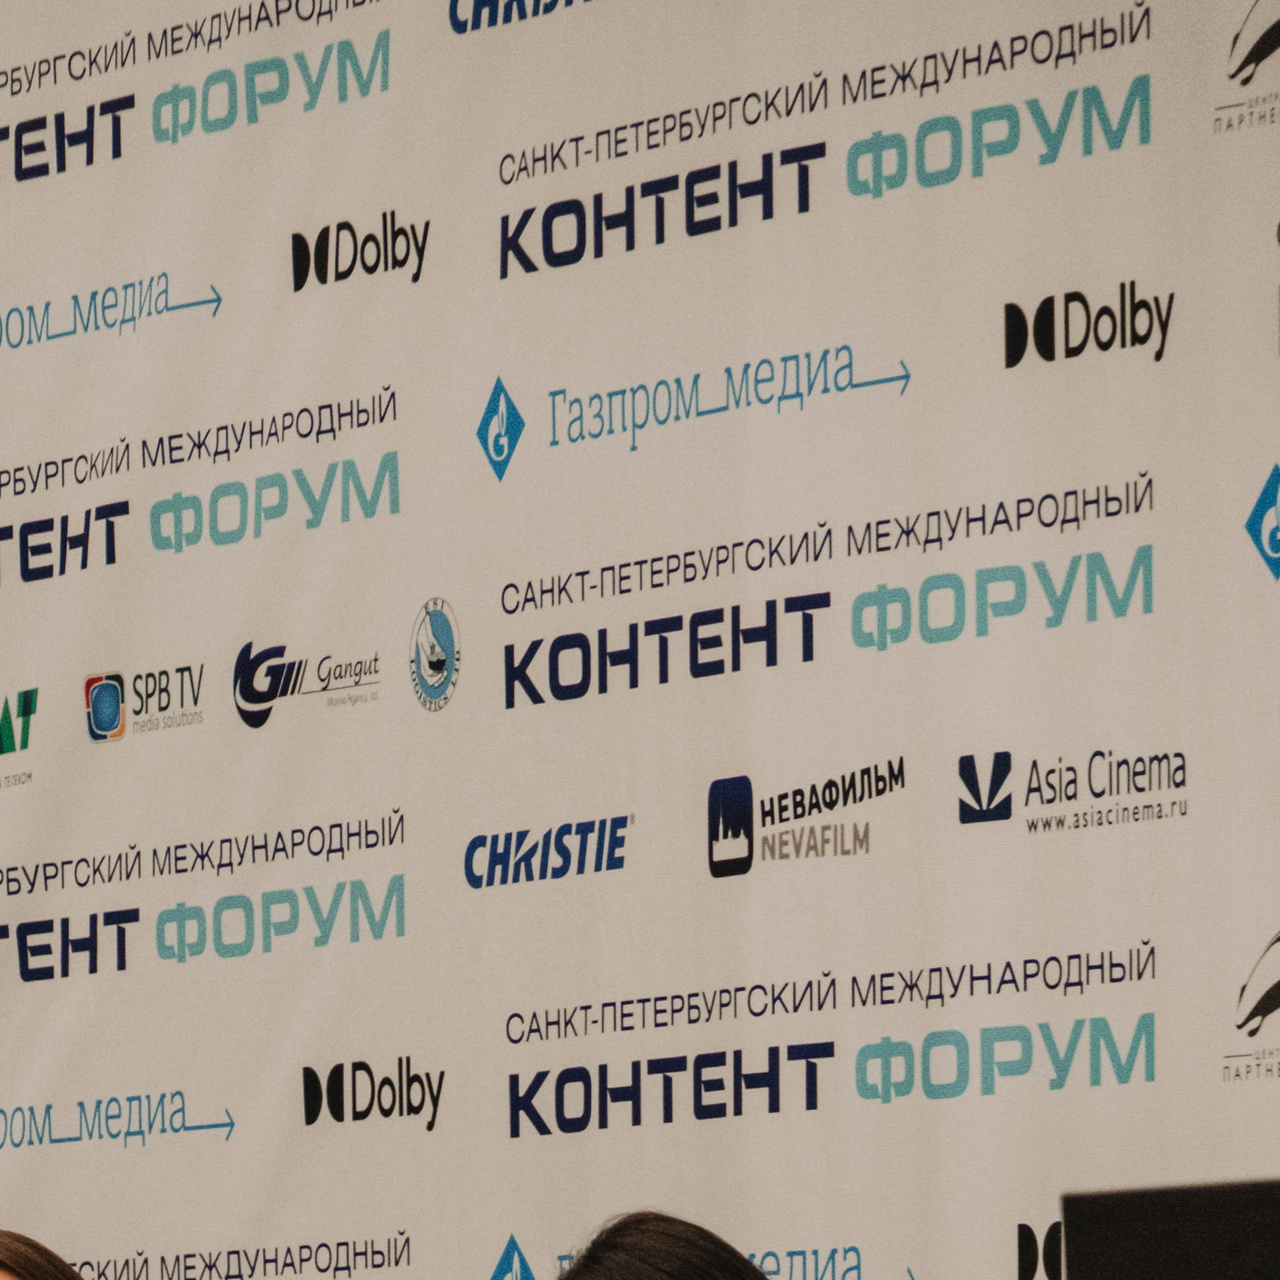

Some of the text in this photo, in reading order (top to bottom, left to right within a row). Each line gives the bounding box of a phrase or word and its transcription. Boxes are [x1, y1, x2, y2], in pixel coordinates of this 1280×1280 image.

[147, 0, 381, 61] МЕЖДУНАРОД
[152, 29, 389, 144] ФОРУМ
[499, 2, 1151, 185] САНКТ-ПЕТЕРБУРГСКИЙ МЕЖДУНАРОДНЫЙ
[499, 74, 1151, 279] КОНТЕНТ ФОРУМ
[334, 211, 430, 283] Dolby
[1065, 281, 1174, 362] Dolby
[142, 384, 397, 470] МЕЖДУНАРОДНЫЙ
[150, 450, 400, 553] ФОРУМ
[500, 470, 1155, 616] САНКТ-ПЕТЕРБУРГСКИЙ МЕЖДУНАРОДНЫЙ
[504, 543, 1154, 710] КОНТЕНТ ФОРУМ
[133, 664, 204, 715] SPB TV
[317, 651, 379, 691] Gangut
[132, 709, 203, 734] media solutions
[760, 756, 906, 828] НЕВАФИЛЬМ
[1025, 748, 1188, 809] Asia Cinema
[1026, 800, 1188, 834] www.asiacinema.ru
[152, 808, 406, 877] МЕЖДУНАРОДНЫЙ
[464, 813, 629, 889] CHRISTIE
[761, 823, 871, 862] NEVAFILM
[155, 873, 406, 964] ФОРУМ
[505, 938, 1157, 1045] САНКТ-ПЕТЕРБУРГСКИЙ МЕЖДУНАРОДНЫЙ
[351, 1055, 446, 1132] Dolby
[508, 1011, 1157, 1139] КОНТЕНТ ФОРУМ
